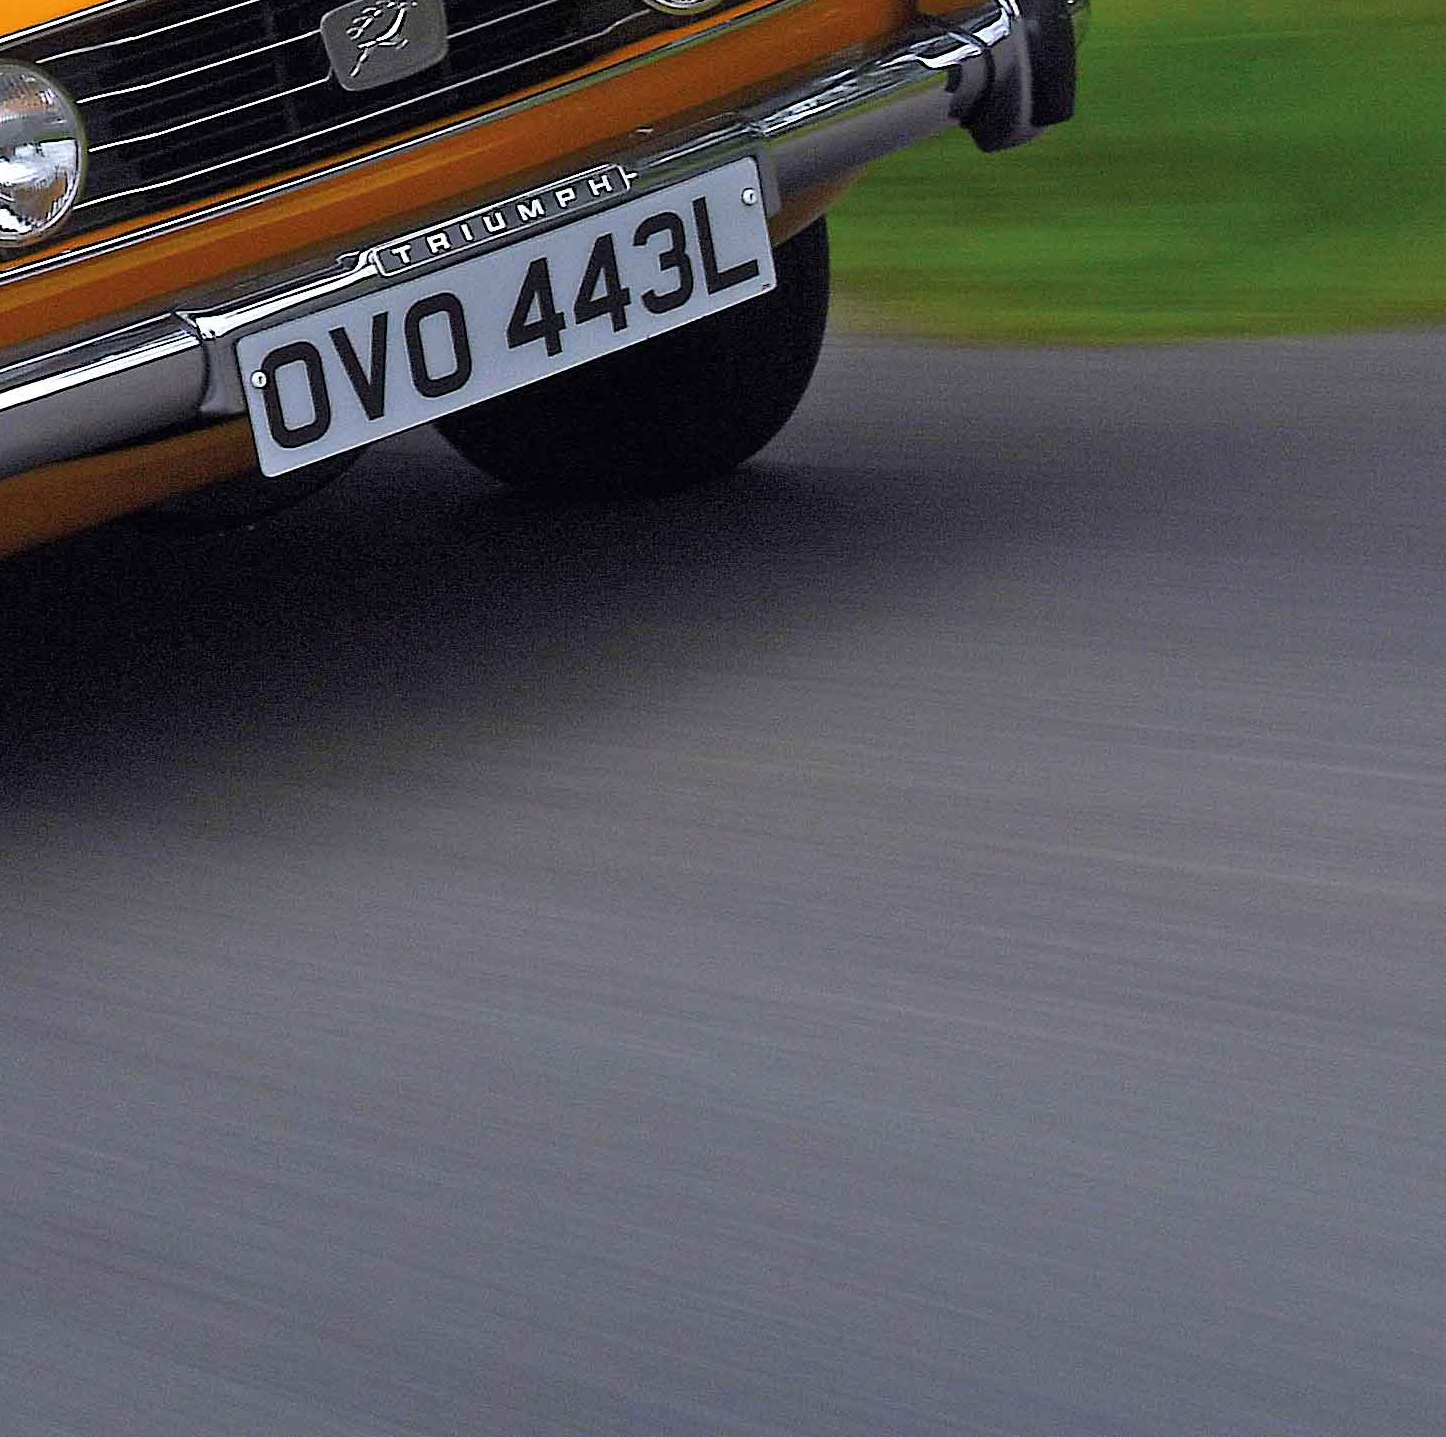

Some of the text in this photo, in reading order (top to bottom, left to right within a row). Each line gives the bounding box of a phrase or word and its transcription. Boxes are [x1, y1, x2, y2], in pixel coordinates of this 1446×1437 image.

[391, 174, 612, 264] TRIUMPH
[261, 196, 760, 449] OVO 443L
